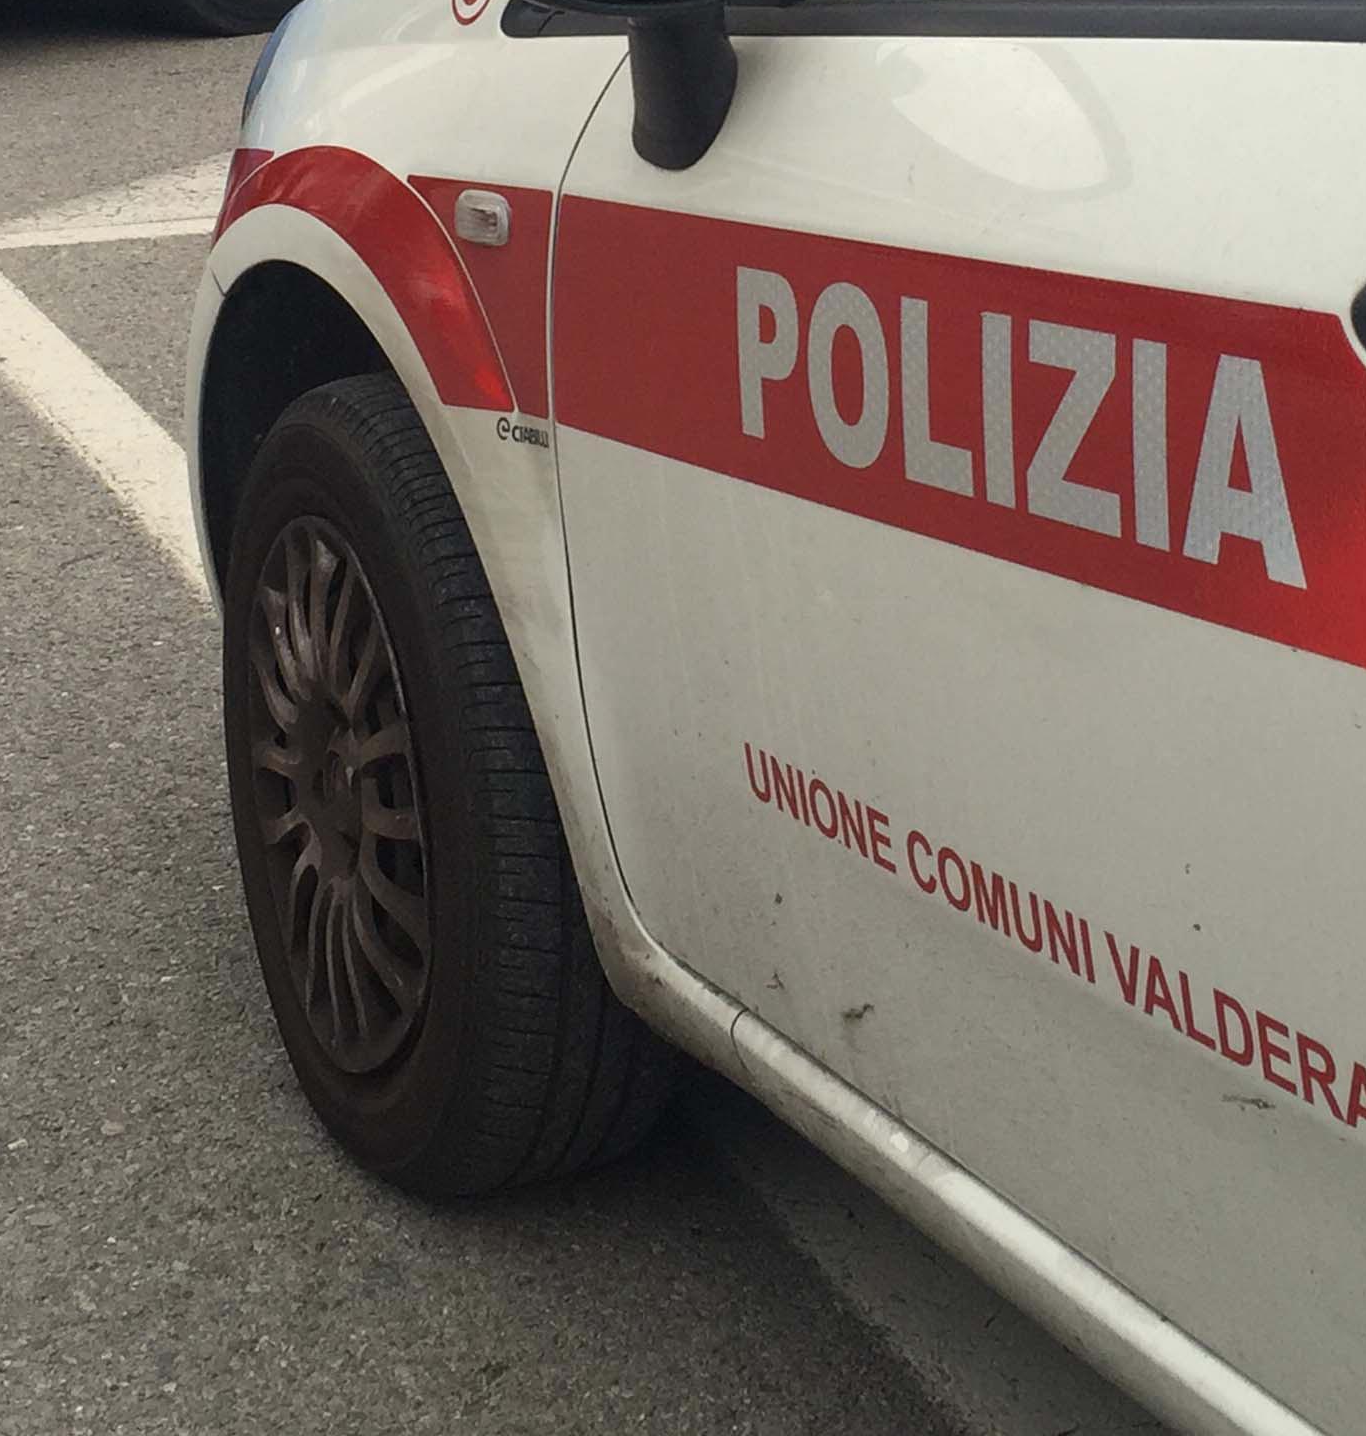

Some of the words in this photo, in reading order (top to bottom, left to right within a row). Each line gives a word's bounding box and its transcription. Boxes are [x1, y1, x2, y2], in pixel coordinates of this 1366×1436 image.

[736, 266, 1307, 590] POLIZIA
[743, 742, 897, 875] UNIONE
[906, 829, 1096, 984] COMUNI
